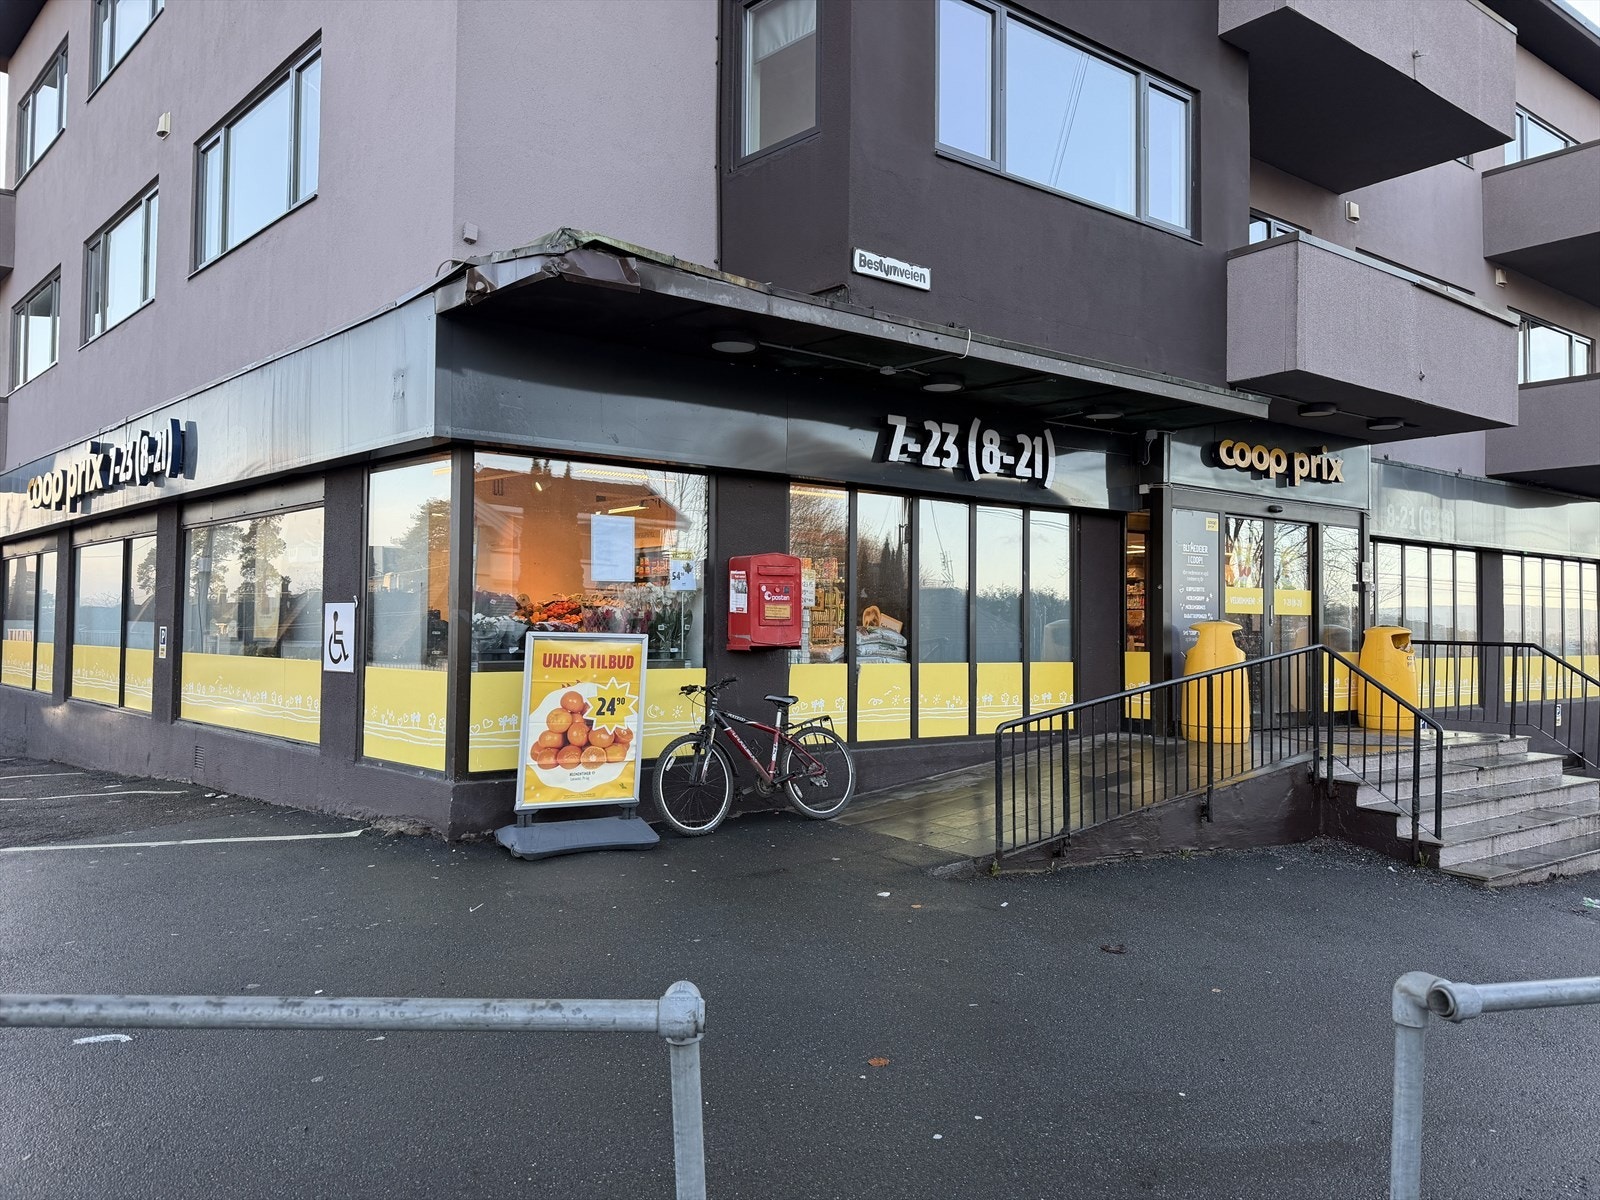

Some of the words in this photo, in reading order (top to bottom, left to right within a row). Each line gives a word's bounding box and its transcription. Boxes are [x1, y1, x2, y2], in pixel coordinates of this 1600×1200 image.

[887, 414, 960, 469] 7-23
[968, 416, 1056, 489] (8-21)
[1219, 439, 1288, 479] coop
[1294, 445, 1345, 487] prix
[27, 468, 63, 511] coop
[66, 440, 104, 512] prix
[771, 594, 790, 602] posten
[542, 652, 587, 669] UKENS
[589, 654, 635, 670] TILBUD
[595, 697, 616, 716] 24
